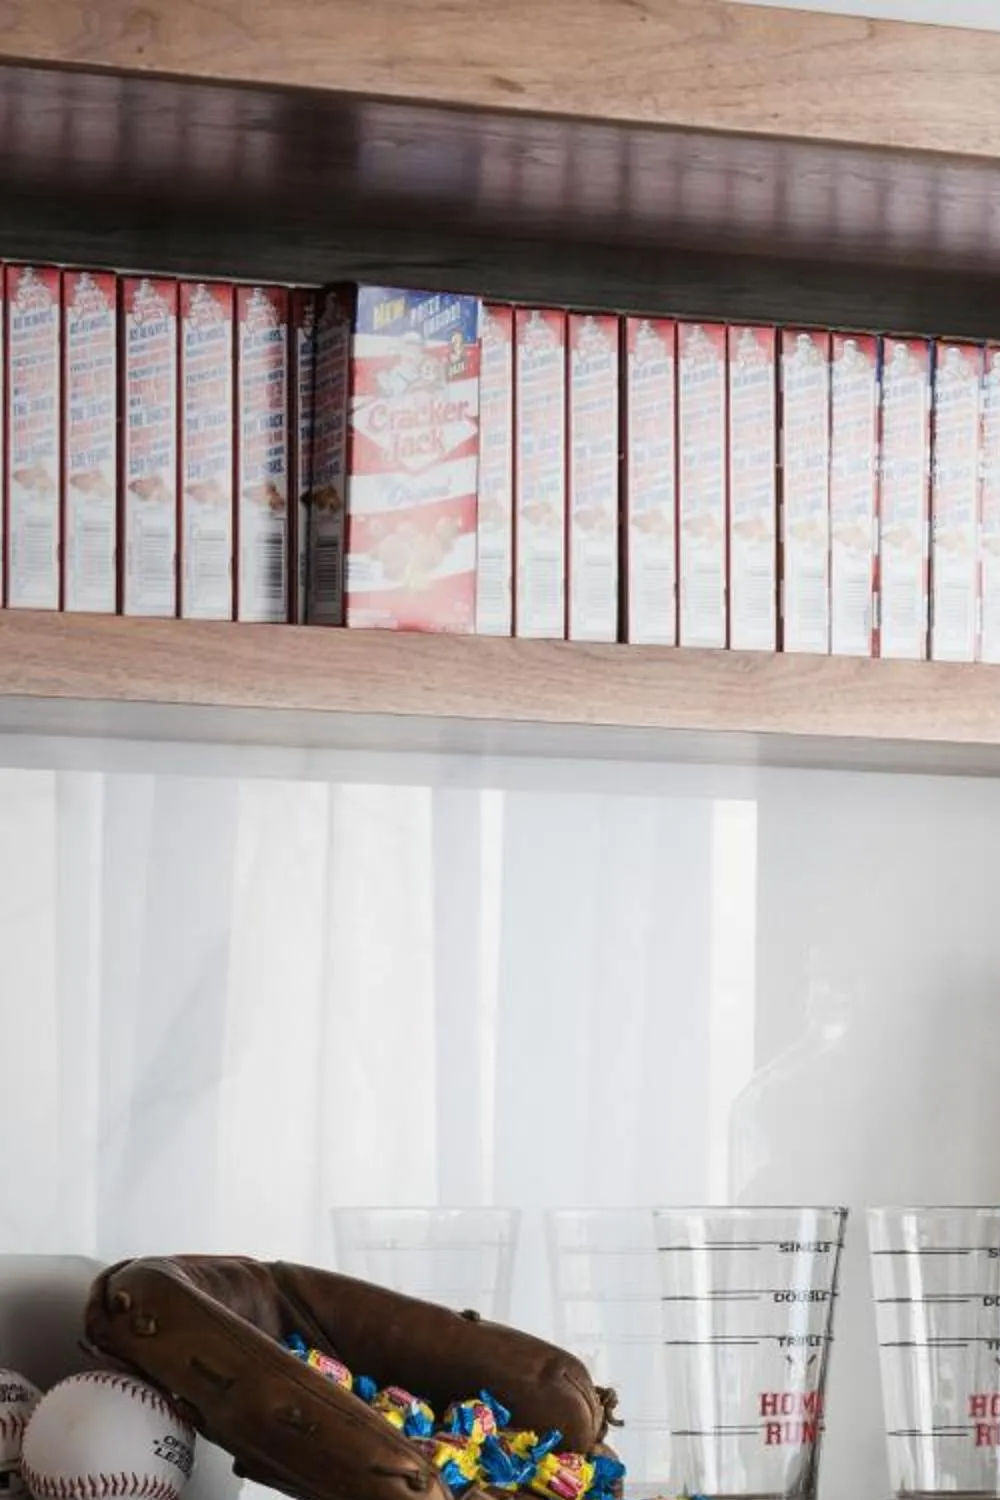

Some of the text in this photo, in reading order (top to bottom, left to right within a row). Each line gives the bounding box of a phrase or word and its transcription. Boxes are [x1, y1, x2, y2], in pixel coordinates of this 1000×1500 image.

[368, 400, 469, 433] Cracker
[384, 428, 444, 462] Jack
[764, 1421, 818, 1445] RUN
